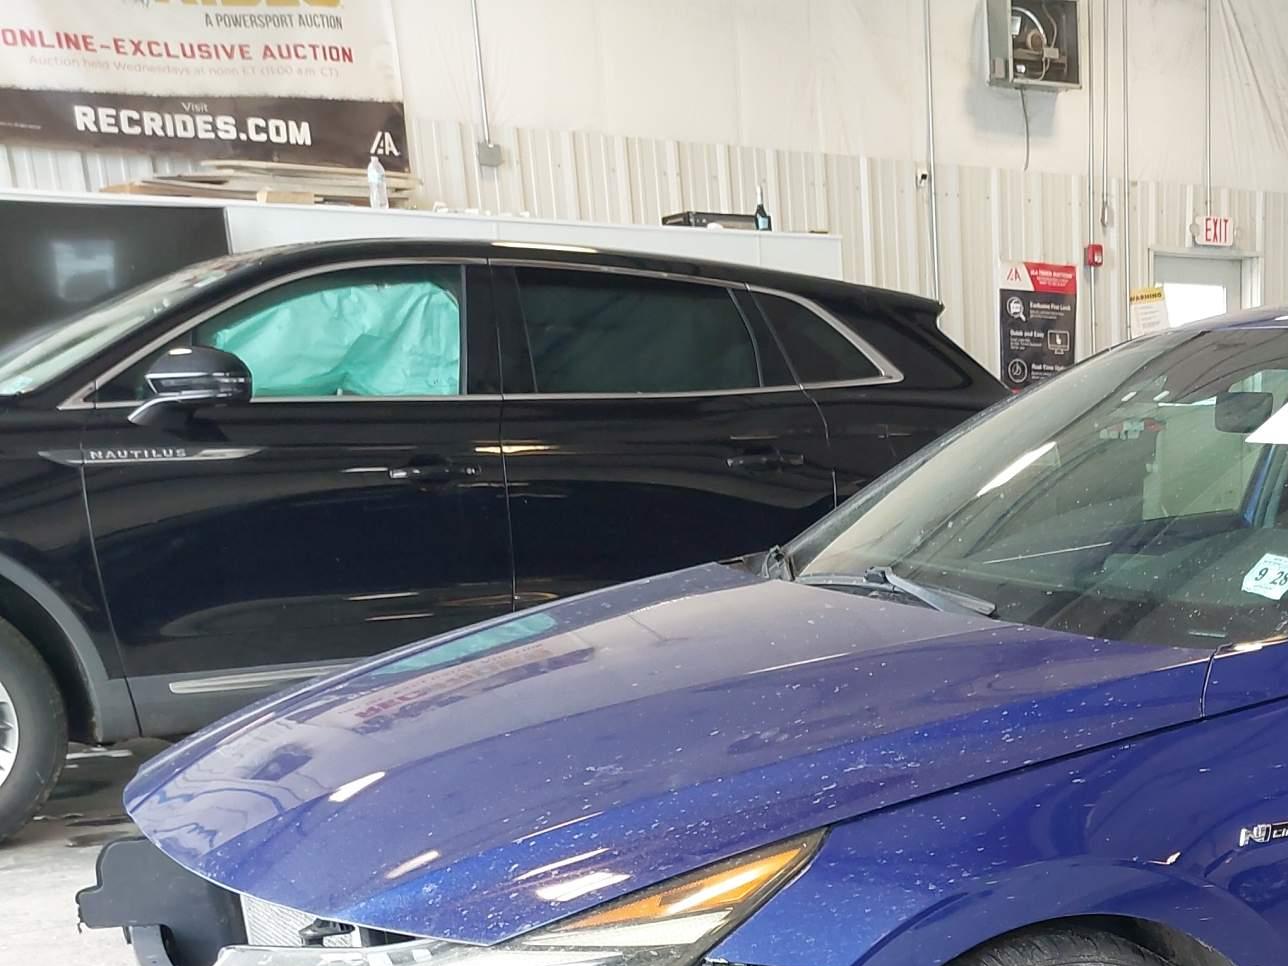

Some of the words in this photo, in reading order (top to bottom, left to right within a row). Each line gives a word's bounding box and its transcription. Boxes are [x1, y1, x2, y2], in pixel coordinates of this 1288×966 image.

[205, 13, 213, 27] A
[216, 13, 295, 28] POWERSPORT
[299, 14, 343, 30] AUCTION
[1, 28, 251, 60] ONLINE-EXCLUSIVE
[262, 44, 353, 63] AUCTION
[181, 102, 208, 112] Visit
[74, 105, 311, 145] RECRIDES.COM
[1205, 218, 1228, 242] EXIT
[1129, 292, 1162, 302] WARNING
[89, 448, 187, 460] NAUTILUS
[1254, 567, 1269, 581] 9
